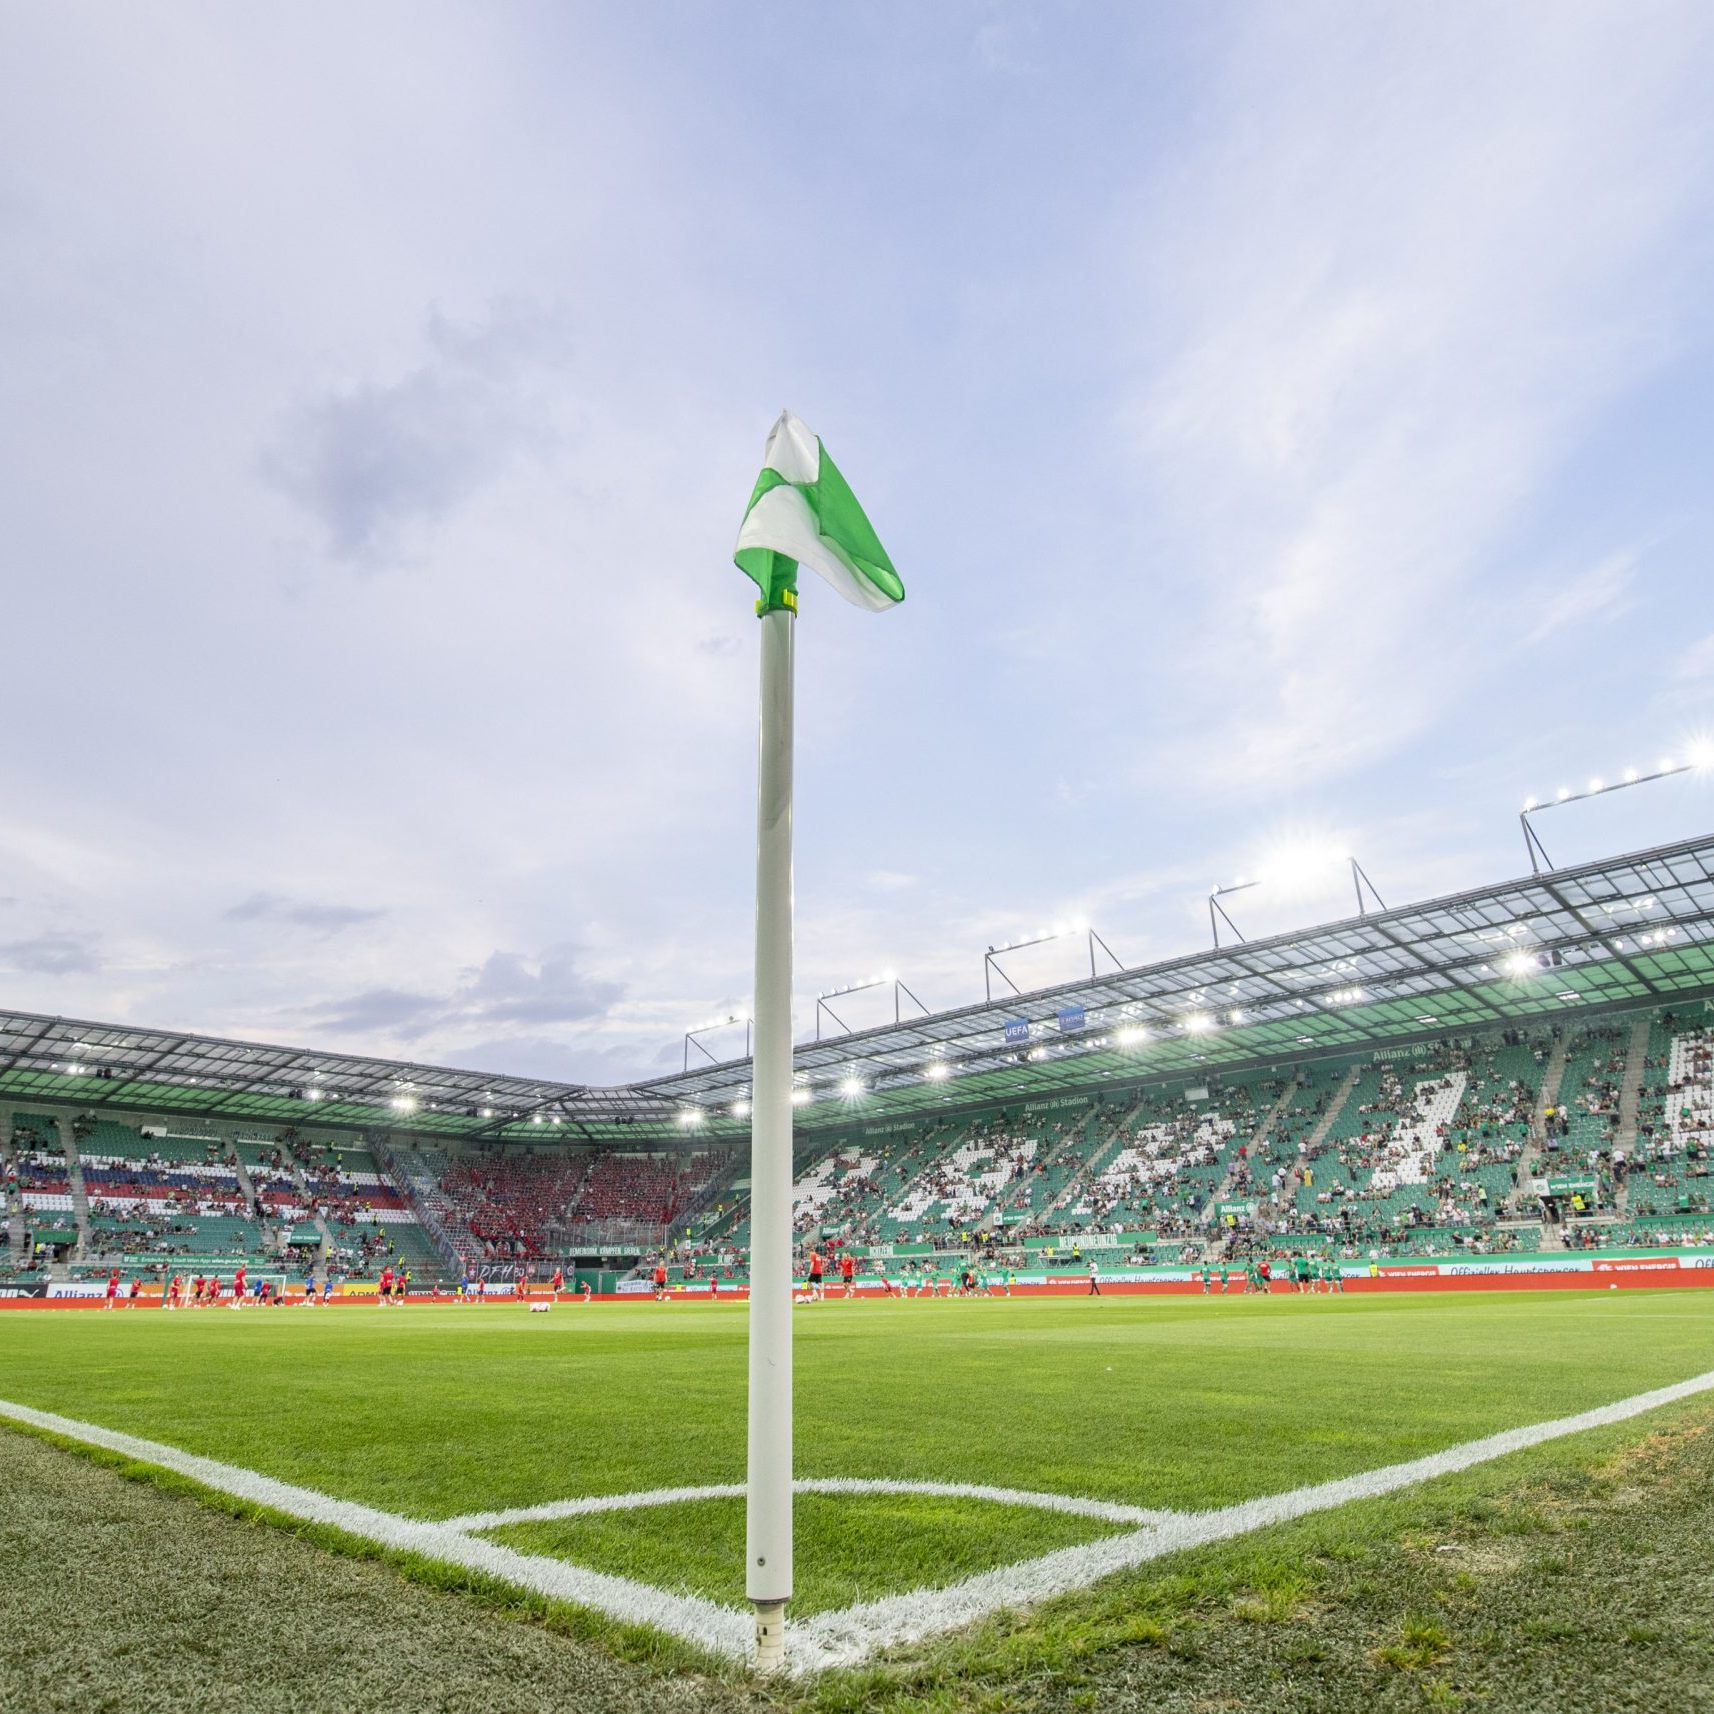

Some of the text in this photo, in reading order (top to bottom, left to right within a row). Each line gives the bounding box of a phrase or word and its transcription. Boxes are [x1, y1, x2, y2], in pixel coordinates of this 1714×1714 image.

[1005, 1025, 1028, 1037] UEFA
[1373, 1048, 1411, 1062] Allianz
[1025, 1096, 1088, 1112] Allianz Stadion
[893, 1122, 915, 1130] Stadion
[1221, 1204, 1246, 1213] Allianz
[1450, 1264, 1580, 1276] Offizieller Hauptsponsor
[55, 1289, 103, 1298] Allianz
